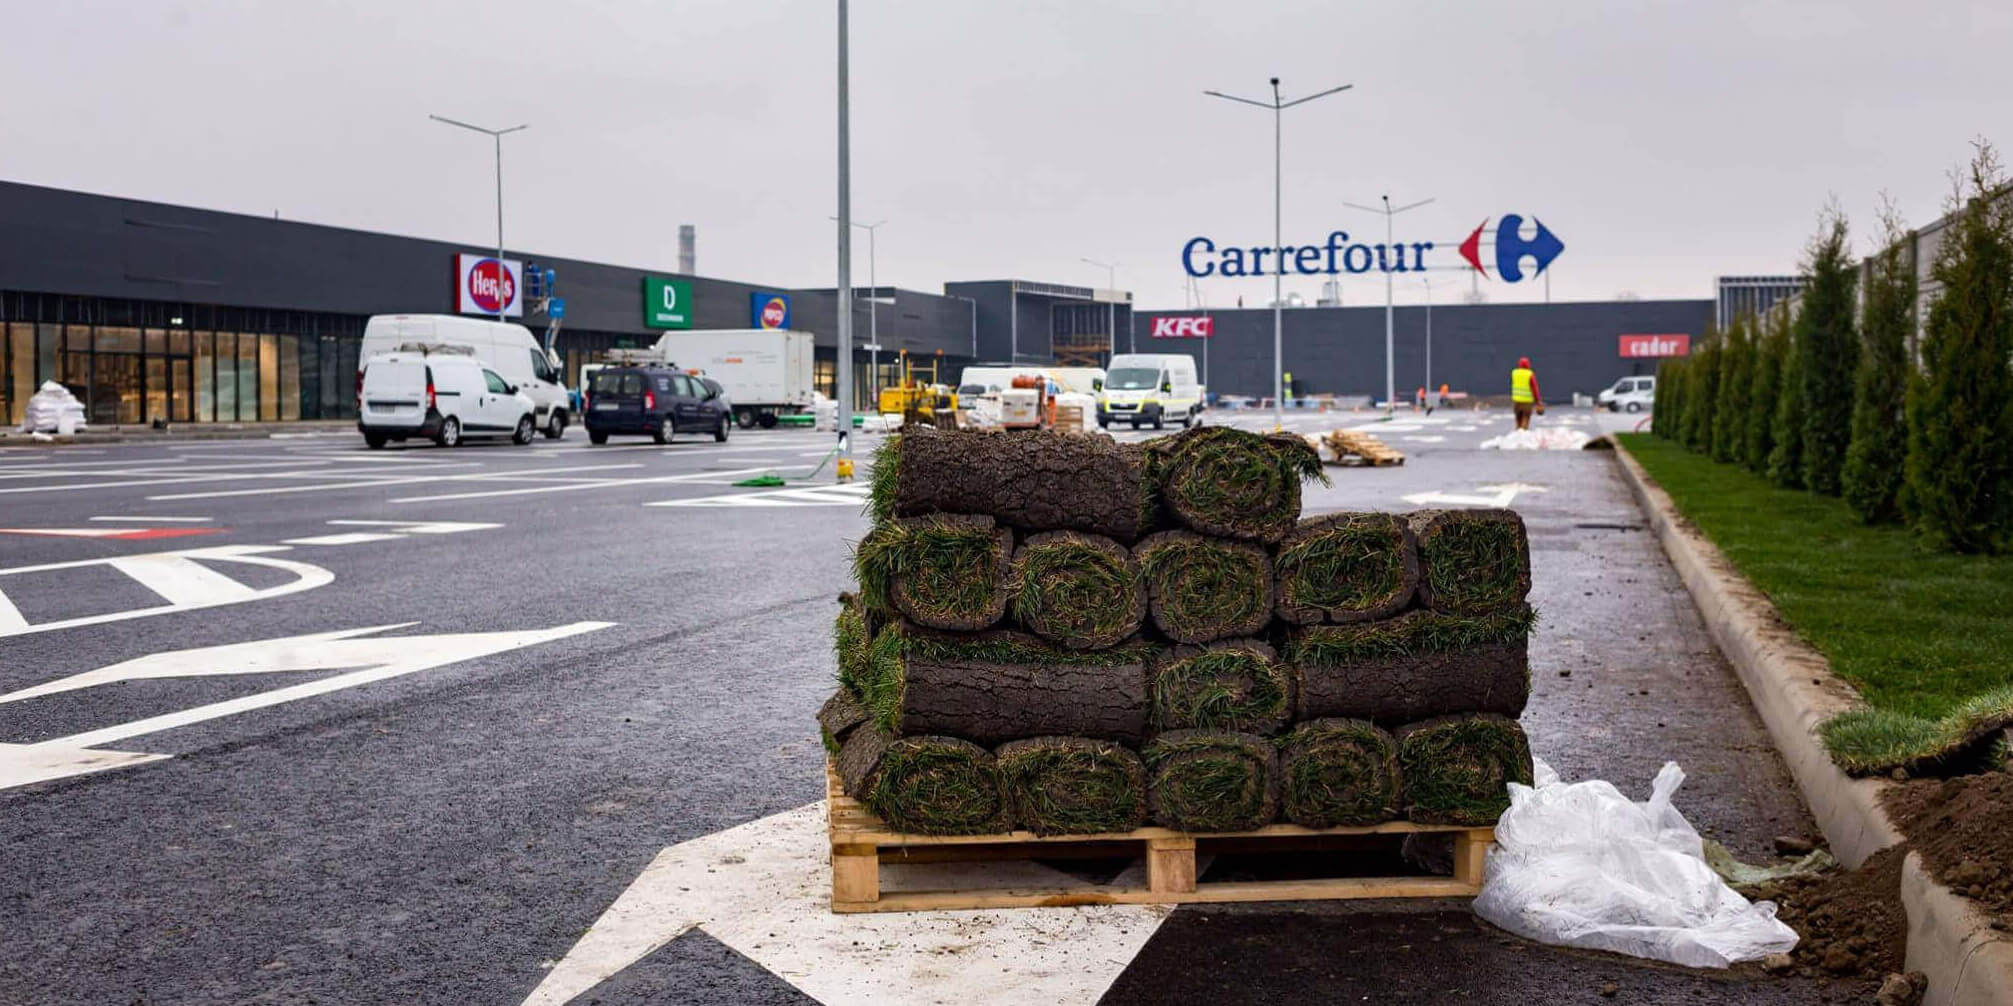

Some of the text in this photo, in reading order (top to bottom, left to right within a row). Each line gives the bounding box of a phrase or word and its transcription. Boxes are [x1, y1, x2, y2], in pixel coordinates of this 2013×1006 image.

[1182, 231, 1433, 278] Carrefour
[663, 285, 676, 310] D
[1152, 317, 1210, 336] KFC
